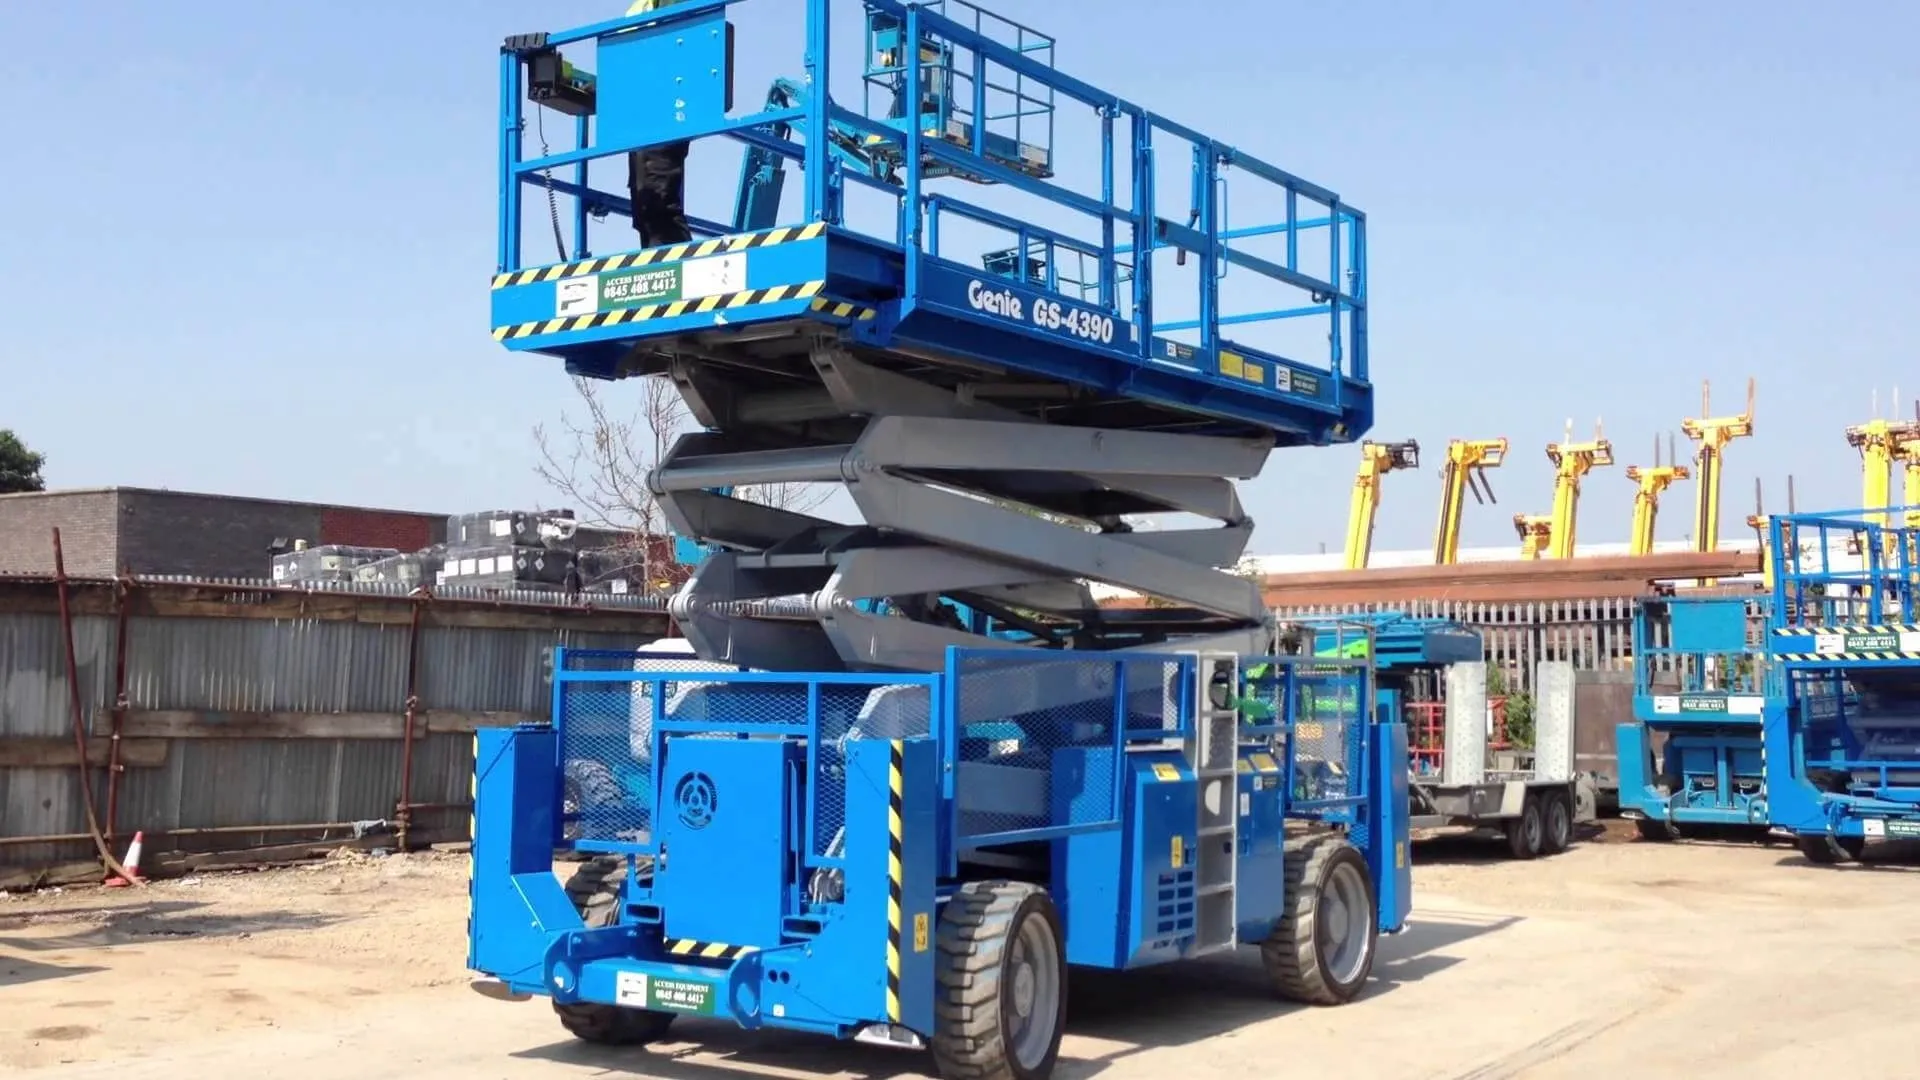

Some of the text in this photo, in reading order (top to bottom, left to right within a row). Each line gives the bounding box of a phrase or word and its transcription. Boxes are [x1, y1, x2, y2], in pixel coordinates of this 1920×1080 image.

[604, 285, 628, 299] 0845
[652, 278, 676, 292] 4412
[606, 270, 676, 286] ACCESS EQUIPMENT
[968, 279, 1114, 344] Genie GS-4390
